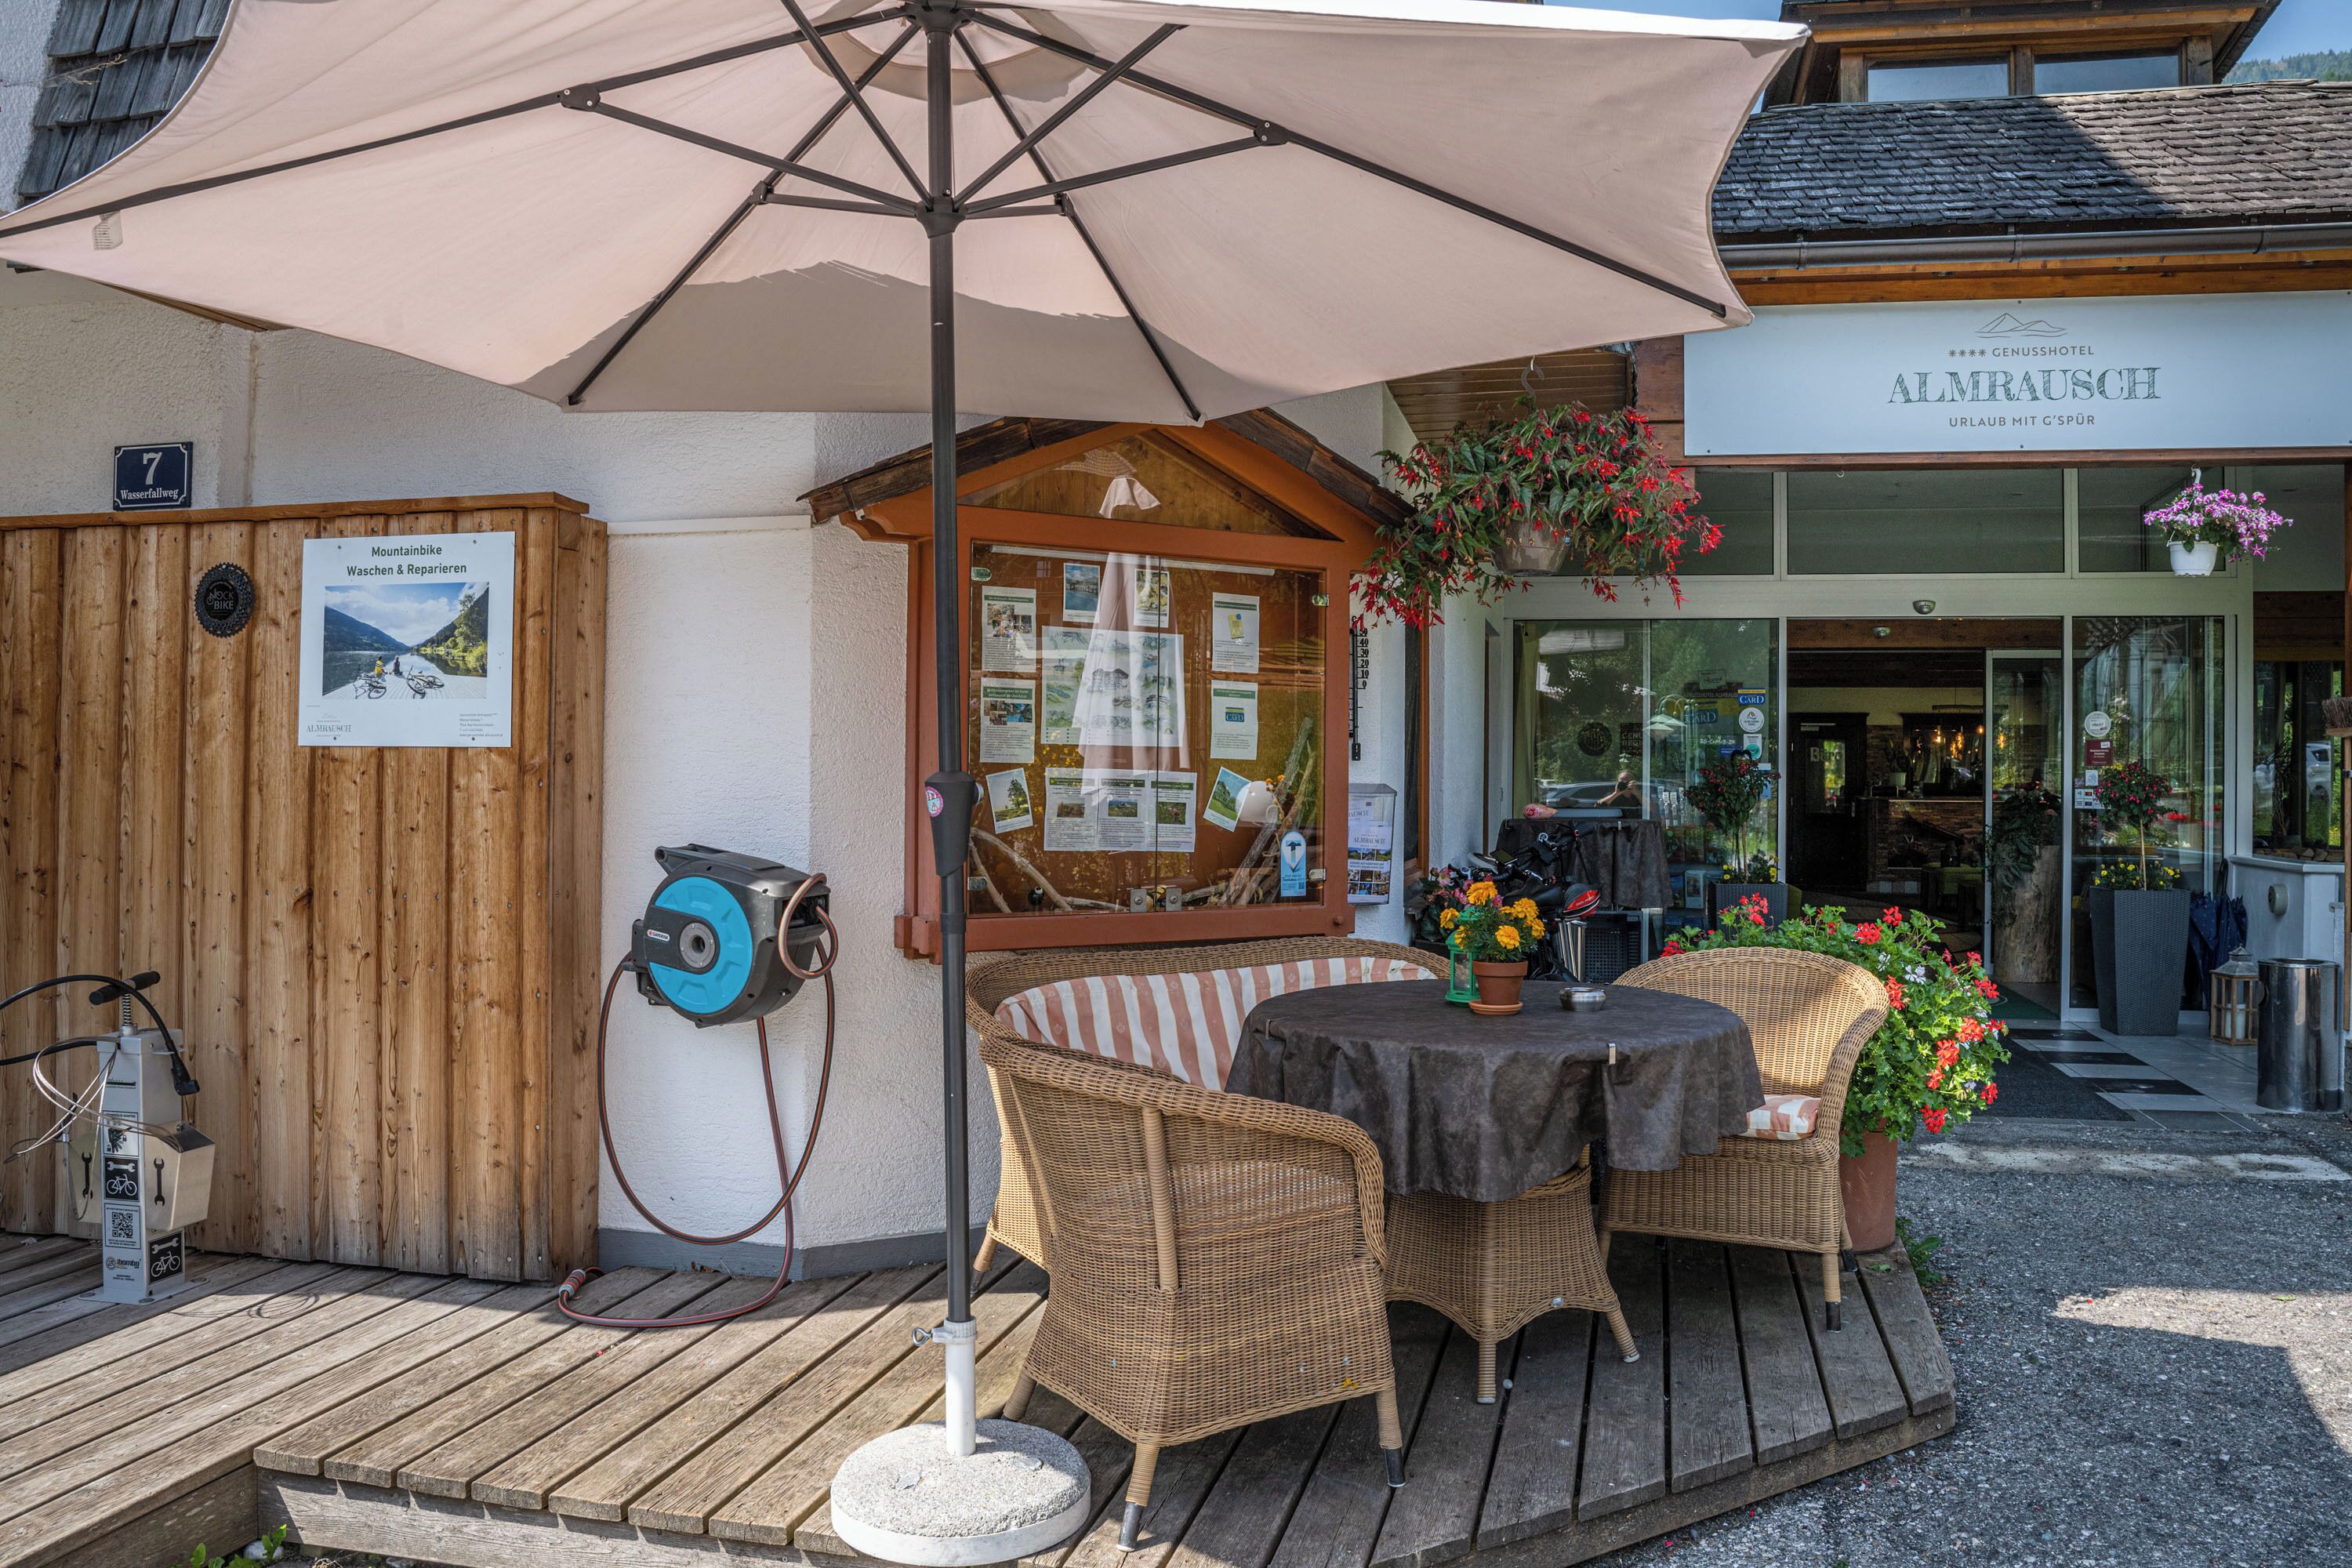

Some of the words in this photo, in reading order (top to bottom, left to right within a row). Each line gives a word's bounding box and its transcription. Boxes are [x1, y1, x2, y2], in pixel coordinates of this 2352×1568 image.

[1992, 346, 2095, 357] GENUSSHOTEL
[1888, 367, 2161, 404] ALMRAUSCH
[1949, 416, 2006, 427] URLAUB
[2013, 416, 2037, 426] MIT
[143, 452, 162, 485] 7
[121, 487, 179, 499] Wasserfallweg
[372, 545, 442, 557] Mountainbike
[347, 565, 394, 576] Waschen
[397, 564, 404, 575] &
[407, 563, 466, 576] Reparieren
[209, 589, 234, 601] NOCK
[214, 601, 234, 610] BIKE
[1360, 670, 1369, 678] 10
[1740, 695, 1764, 703] CARD
